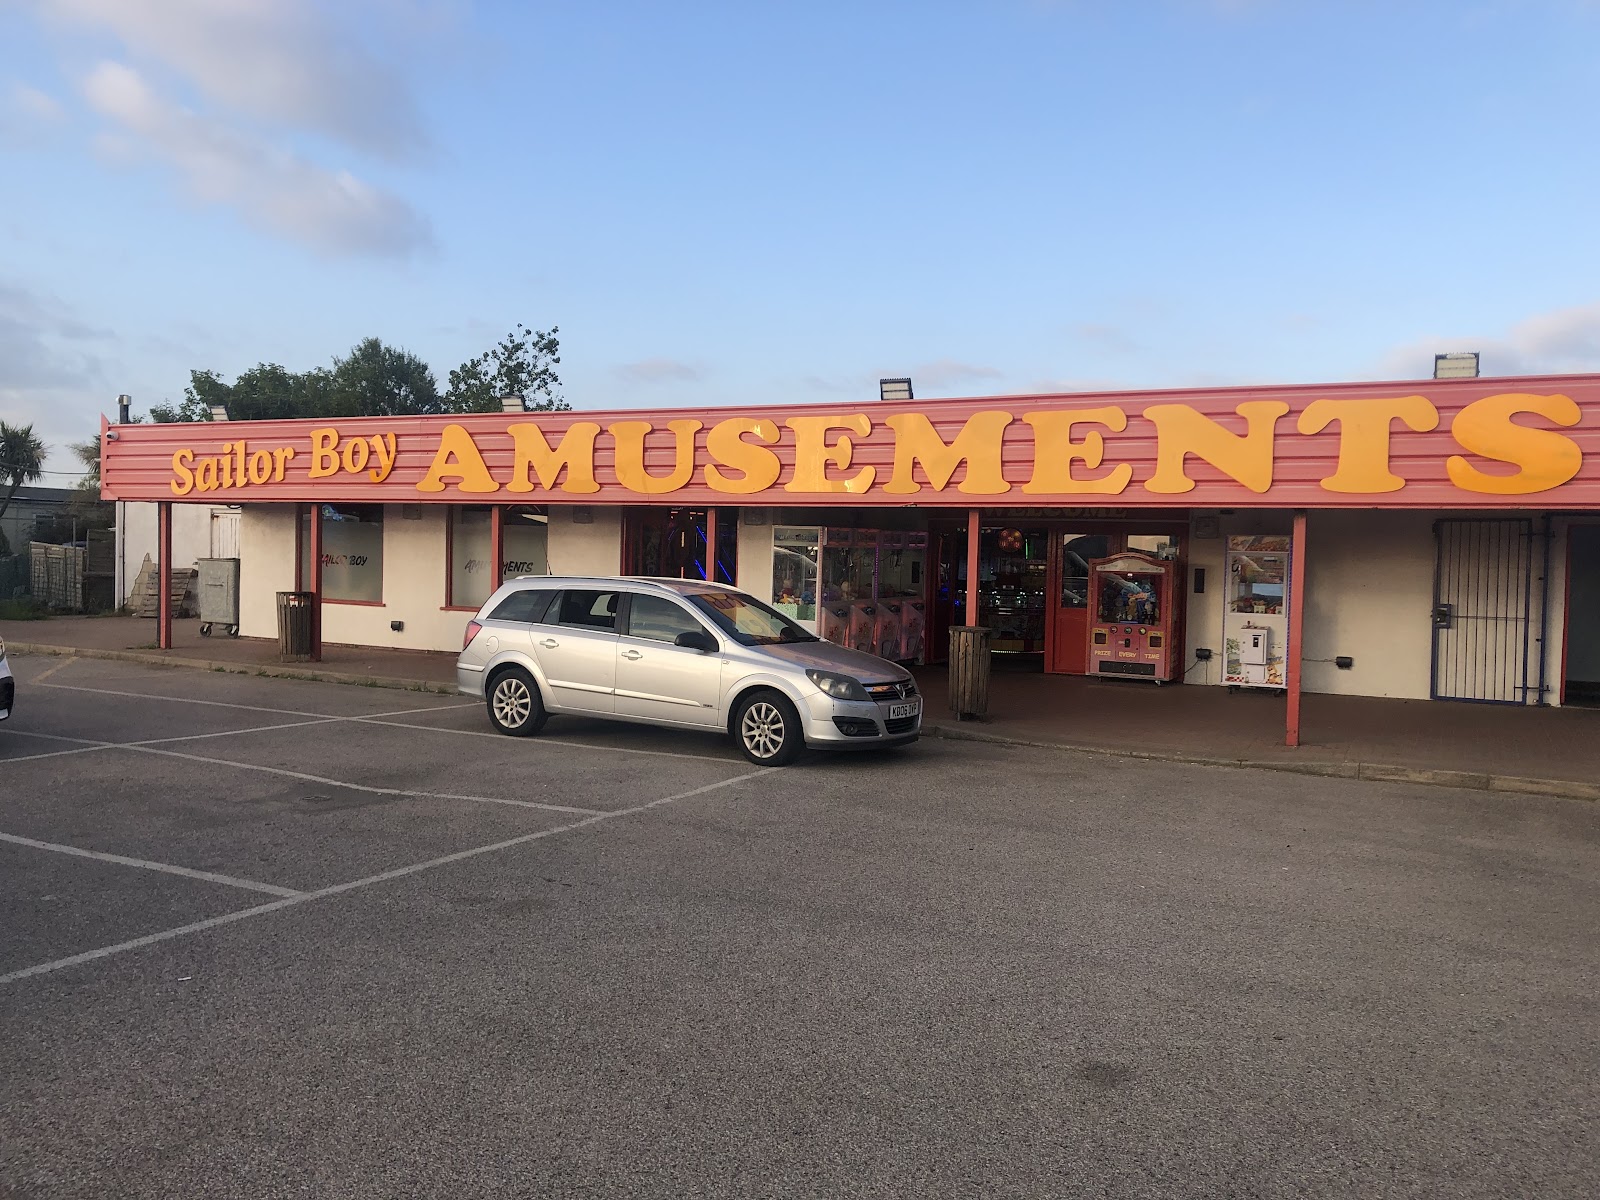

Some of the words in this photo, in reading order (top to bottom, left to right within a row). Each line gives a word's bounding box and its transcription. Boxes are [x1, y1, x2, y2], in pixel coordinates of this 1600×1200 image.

[170, 439, 295, 495] Sailor
[307, 427, 397, 482] Boy
[415, 394, 1584, 495] AMUSEMENTS
[349, 555, 368, 566] BOY
[1094, 649, 1112, 657] PRIZE
